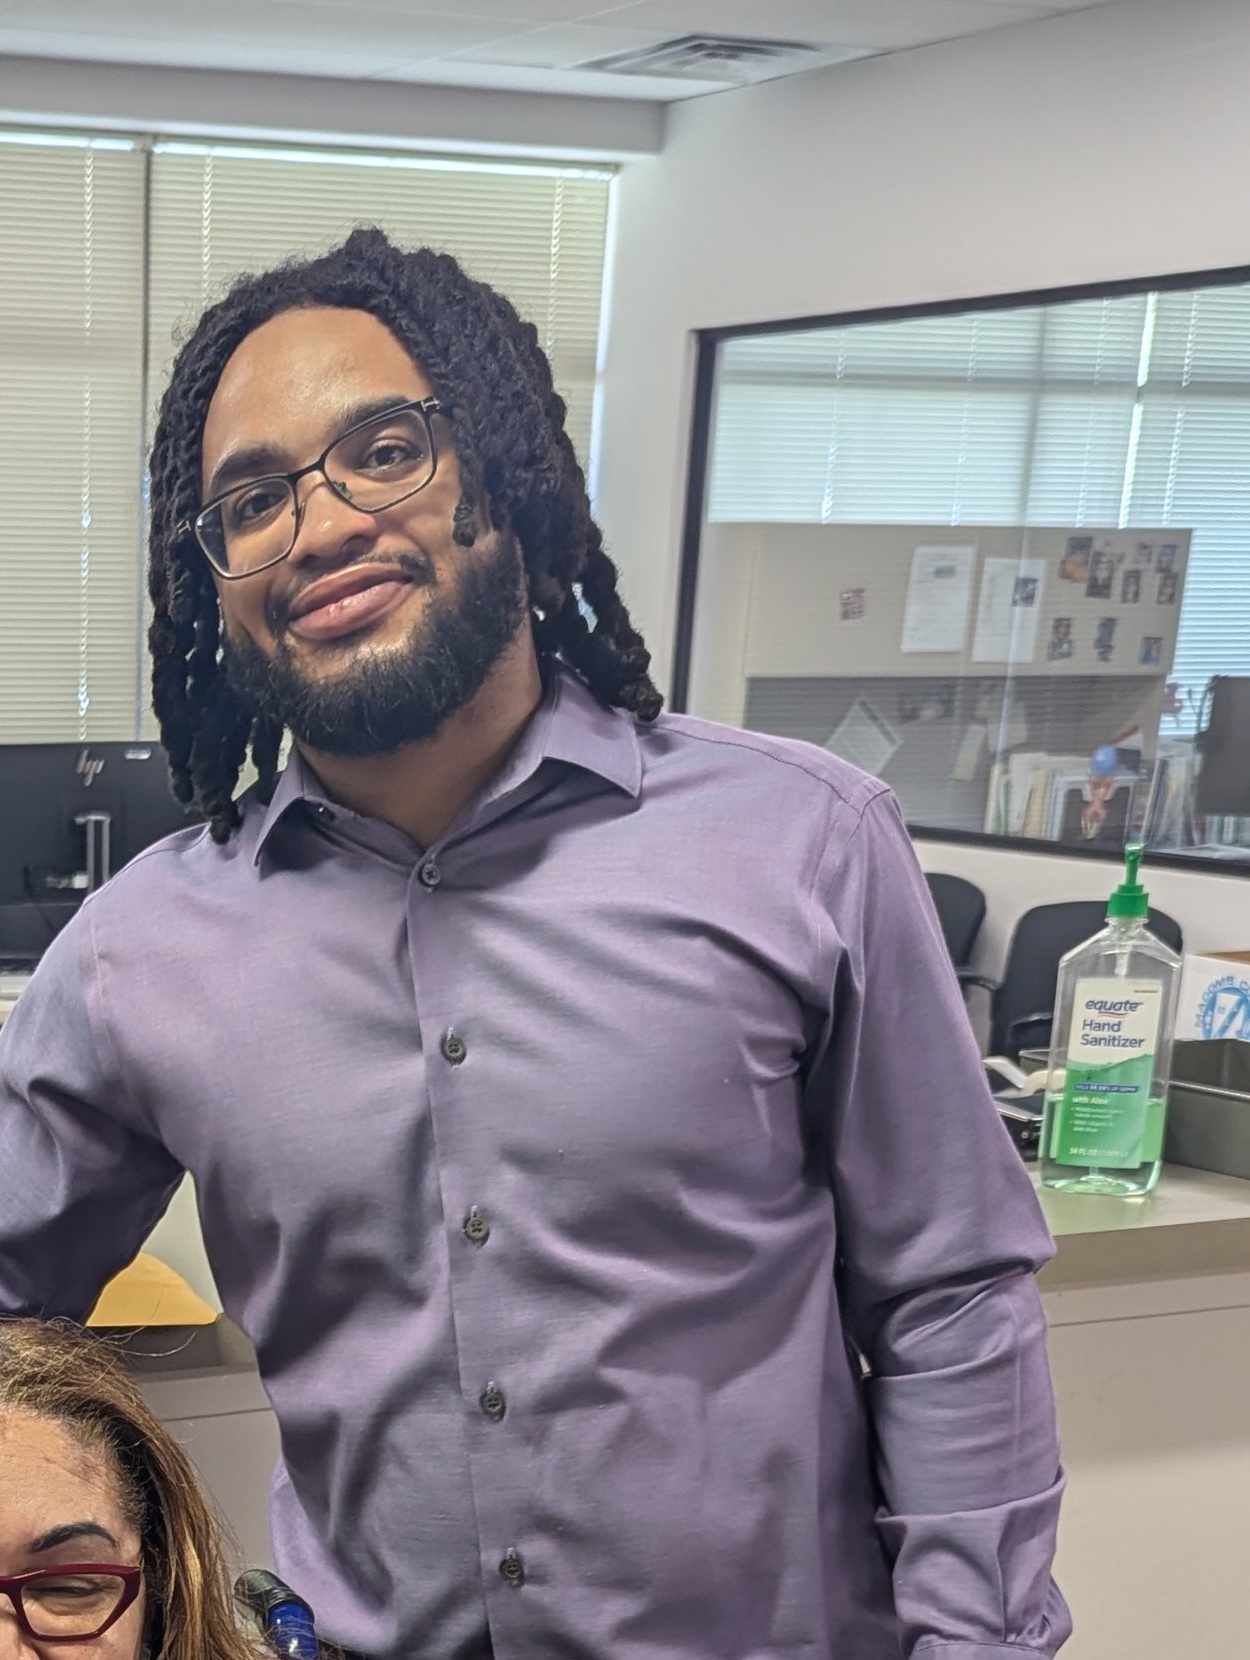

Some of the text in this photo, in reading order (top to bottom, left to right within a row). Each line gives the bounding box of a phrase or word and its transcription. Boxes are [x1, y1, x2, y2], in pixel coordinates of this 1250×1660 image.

[1085, 1000, 1140, 1013] equate
[1082, 1019, 1122, 1033] Hand
[1080, 1034, 1146, 1048] Sanitizer
